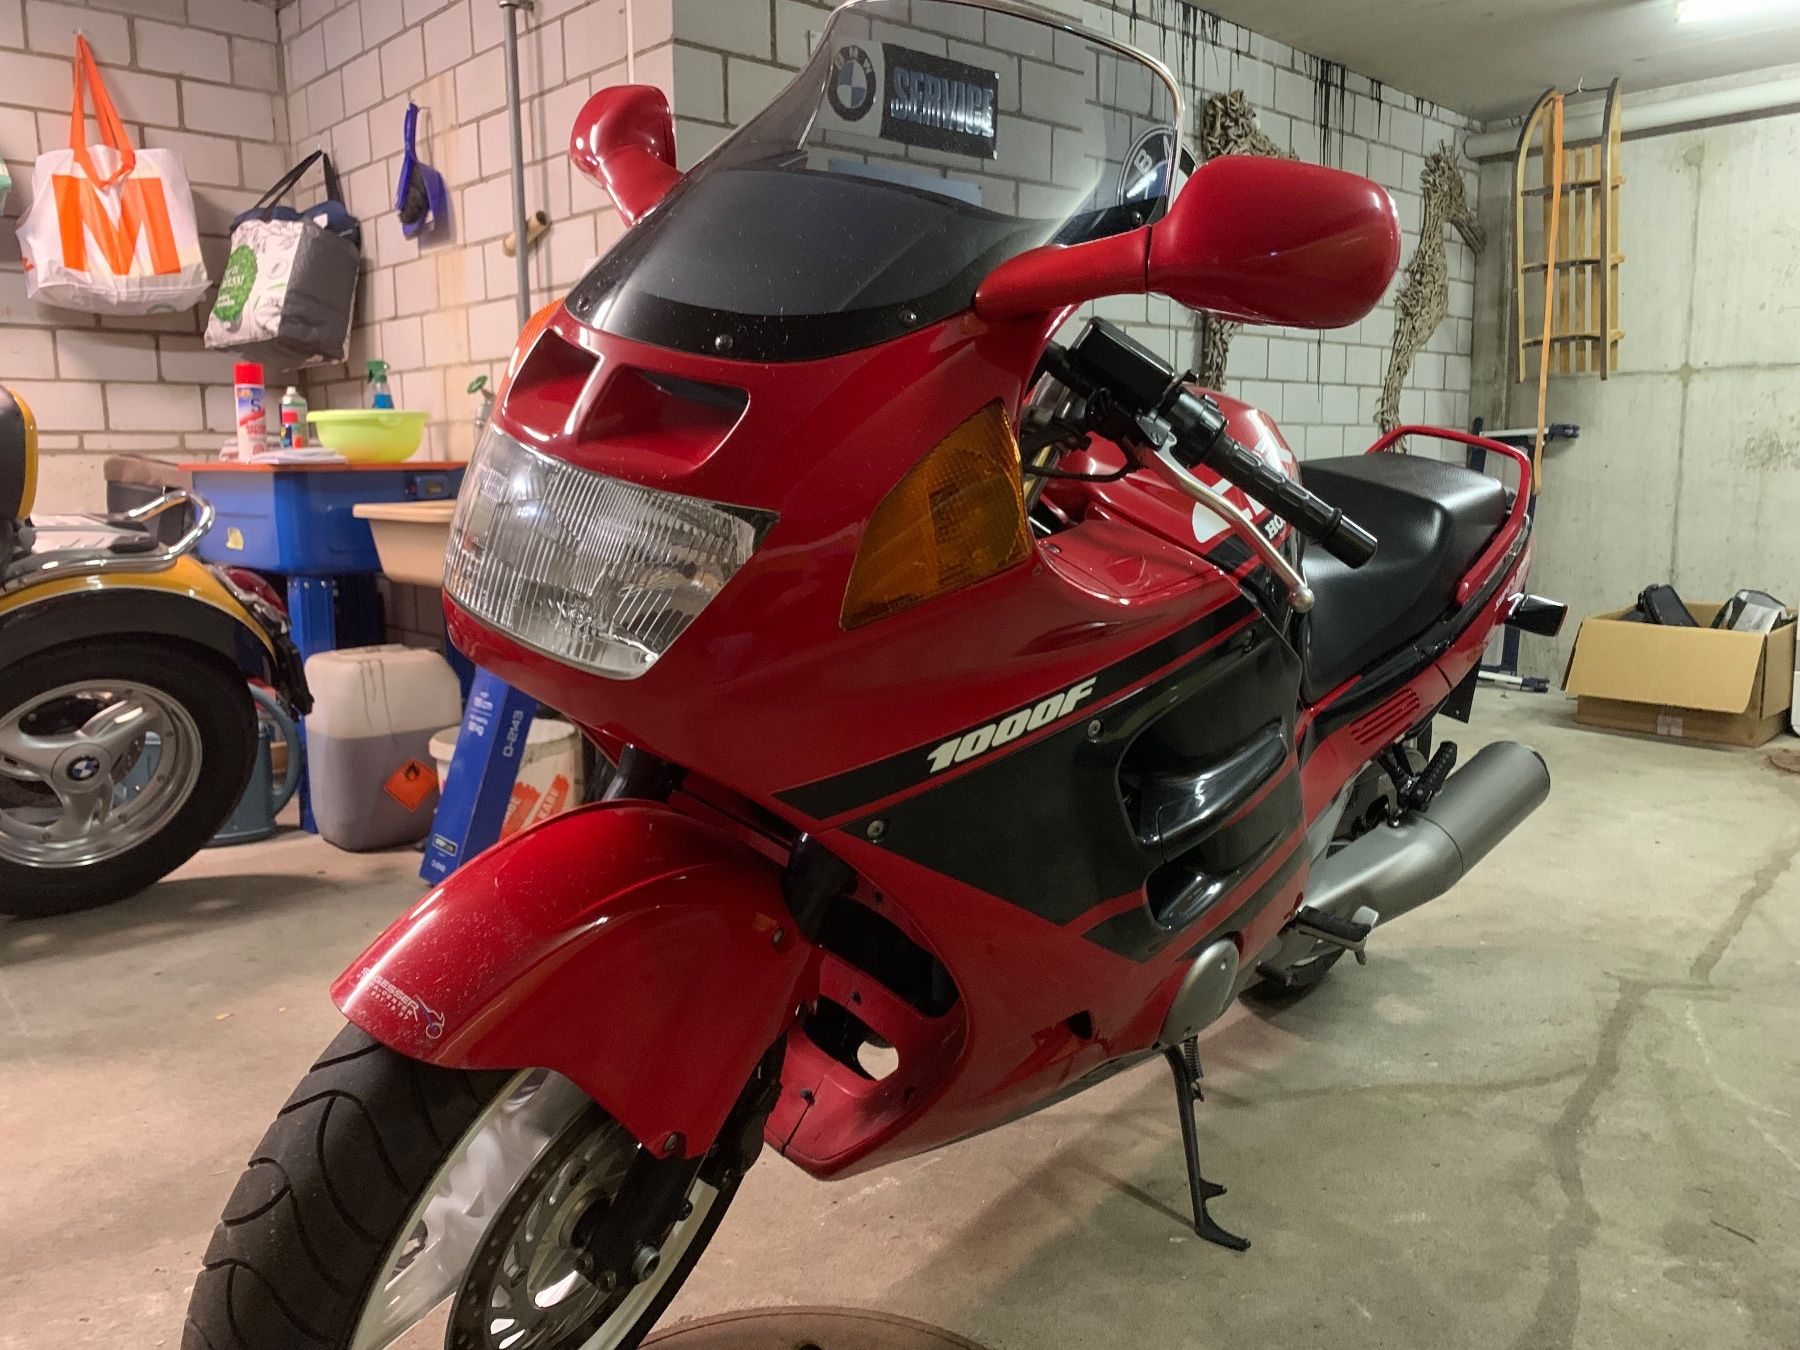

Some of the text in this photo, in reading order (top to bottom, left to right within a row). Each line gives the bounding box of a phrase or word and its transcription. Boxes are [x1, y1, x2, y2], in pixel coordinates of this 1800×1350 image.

[890, 65, 995, 138] SERVICE
[52, 174, 182, 276] M
[926, 676, 1097, 774] 1000F
